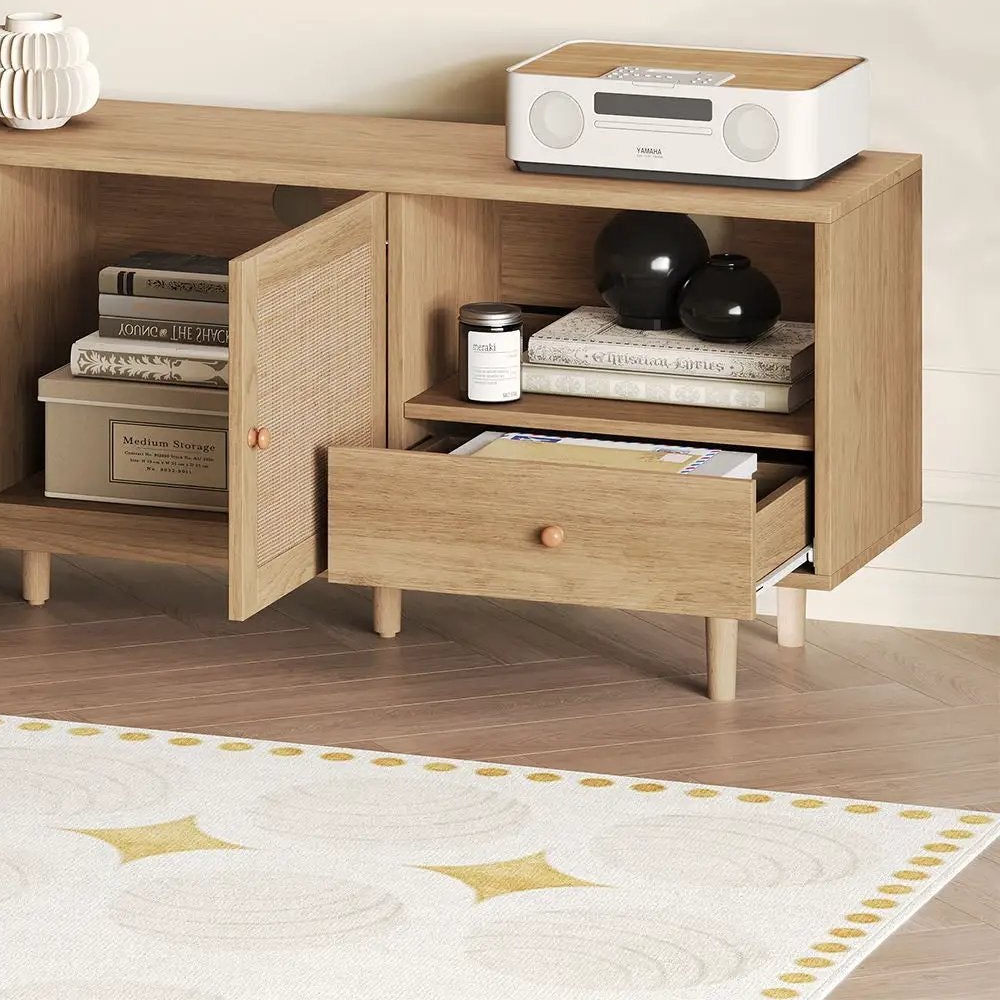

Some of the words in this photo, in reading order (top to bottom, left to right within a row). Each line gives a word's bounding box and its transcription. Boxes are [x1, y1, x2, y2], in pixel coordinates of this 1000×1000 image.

[636, 147, 662, 155] YAMAHA
[122, 435, 169, 448] Medium
[172, 440, 216, 453] Storage
